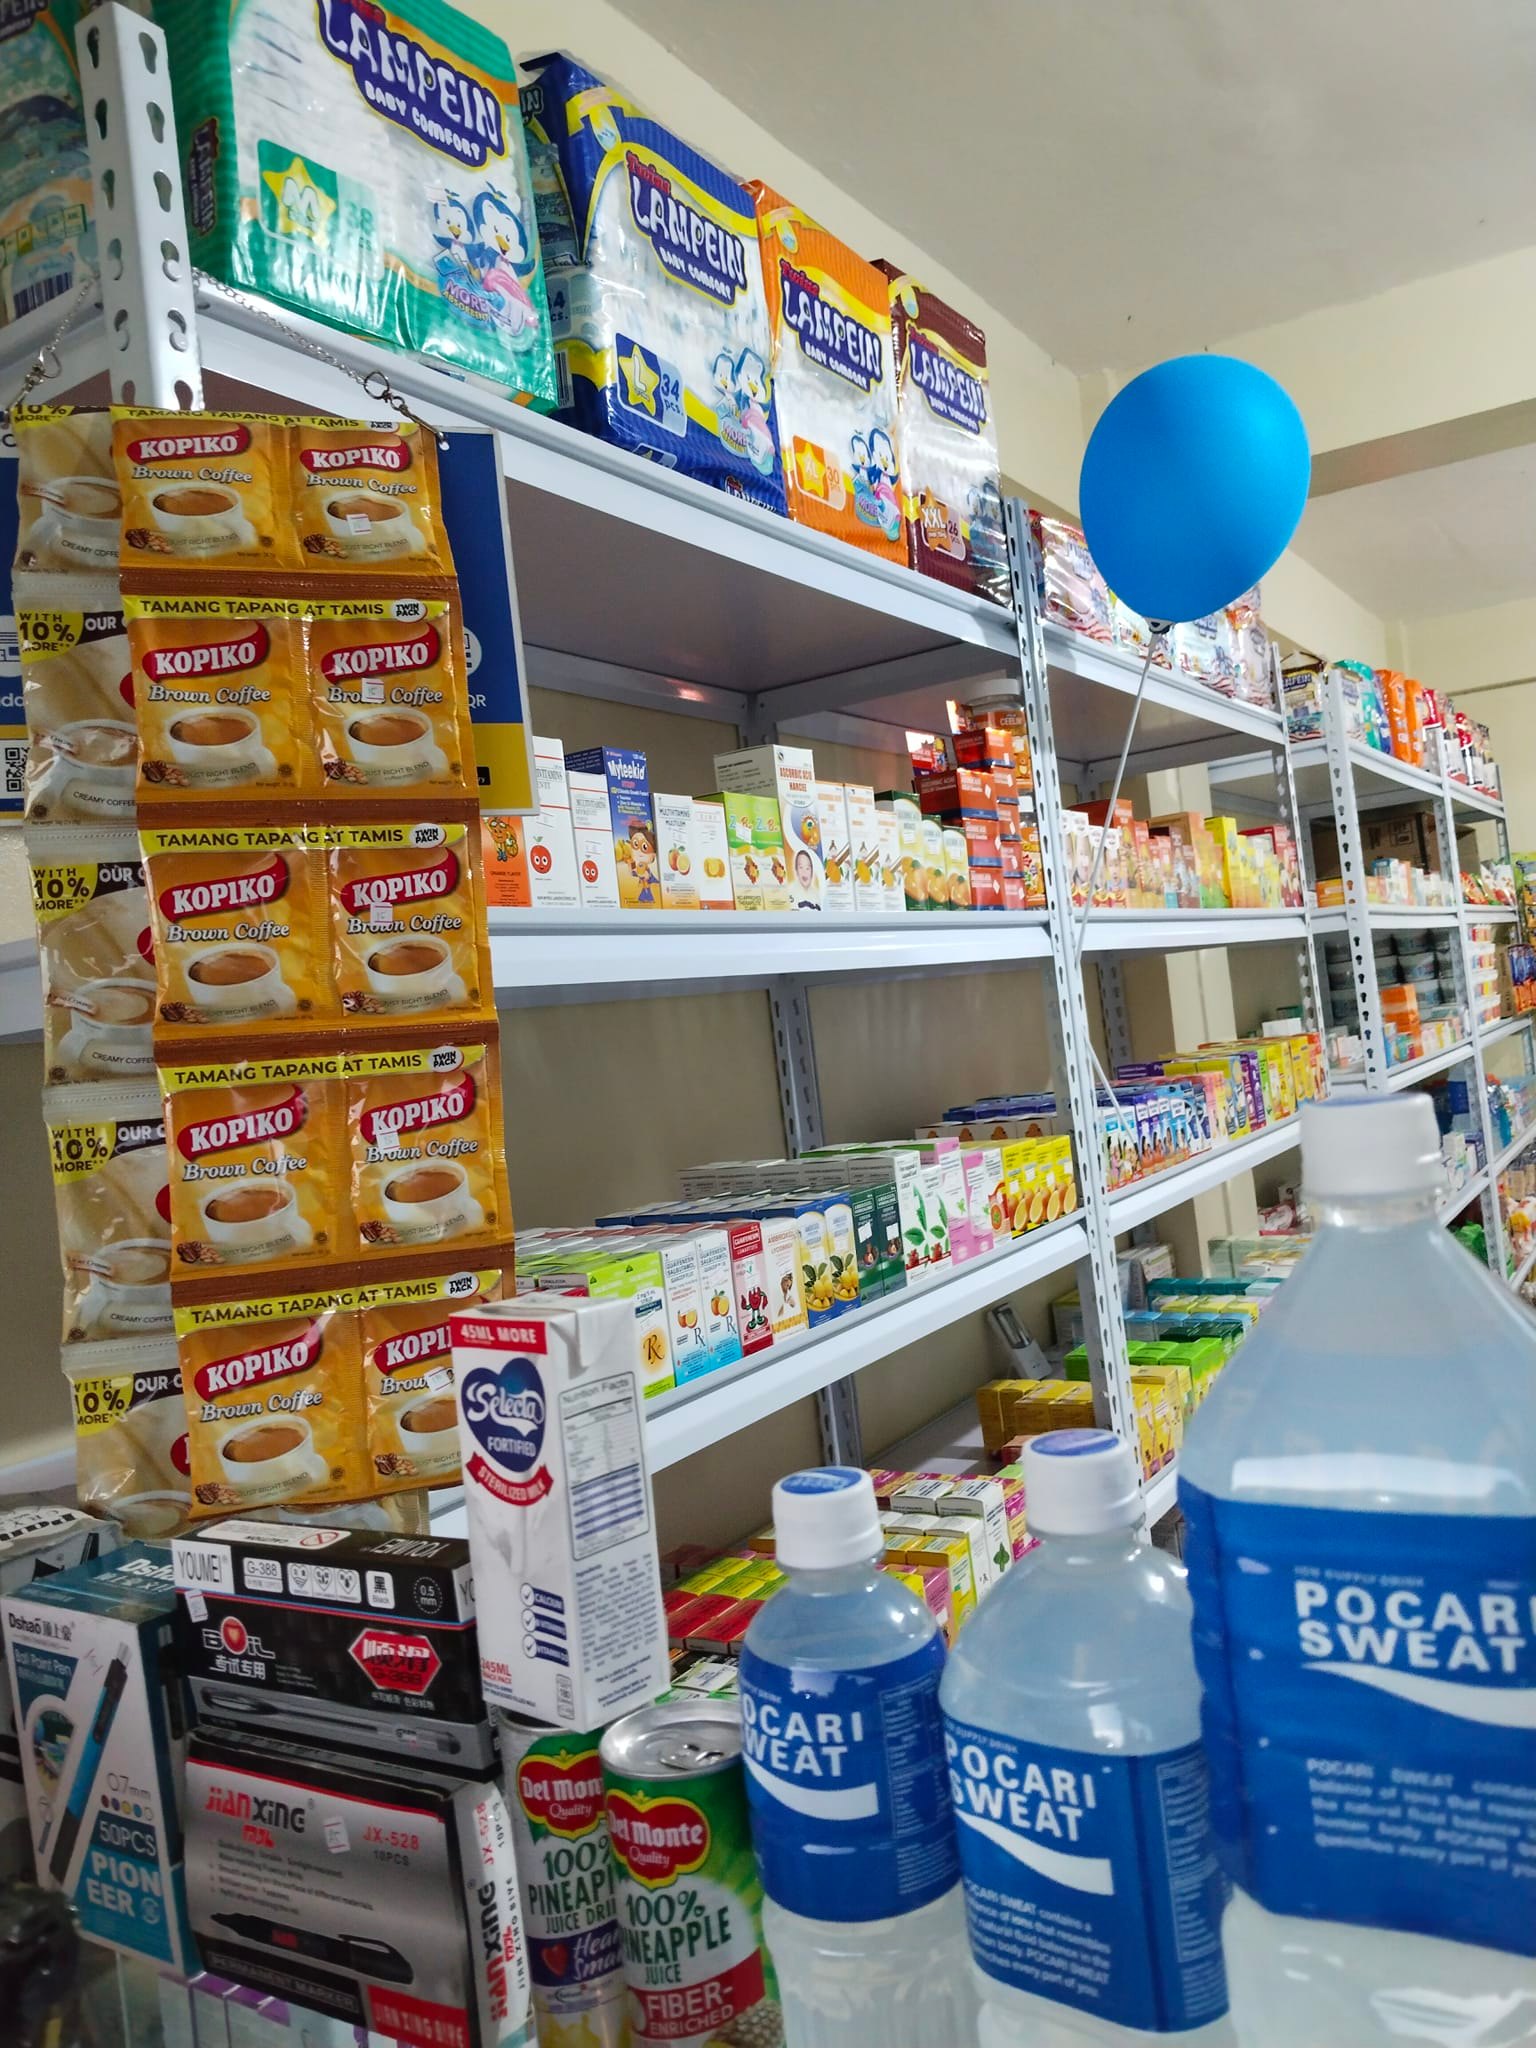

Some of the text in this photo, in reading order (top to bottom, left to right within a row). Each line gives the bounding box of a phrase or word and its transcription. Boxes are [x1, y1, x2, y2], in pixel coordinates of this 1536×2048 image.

[324, 0, 499, 147] LAMPEIN
[364, 80, 407, 116] BABY
[633, 175, 745, 286] LAMPEIN
[659, 246, 733, 300] BABY COMFORT
[784, 281, 882, 379] LAMPEIN
[633, 354, 649, 392] L
[805, 342, 868, 390] BABY COMFORT
[660, 373, 681, 402] 34
[910, 343, 987, 420] LAMPEIN
[310, 417, 359, 428] TAMIS
[139, 436, 239, 460] KOPIKO
[311, 448, 400, 470] KOPIKO
[132, 466, 253, 484] Brown Coffee
[307, 474, 417, 496] Brown Coffee
[922, 507, 947, 529] XXL
[61, 539, 92, 554] CREAMY
[19, 612, 63, 623] WITH
[141, 600, 384, 617] TAMANG TAPANG AT TAMIS
[395, 603, 420, 611] TWIN
[395, 609, 420, 618] PACK
[19, 622, 76, 643] 10%
[85, 615, 117, 631] OUR
[154, 642, 256, 676] KOPIKO
[332, 644, 429, 677] KOPIKO
[149, 685, 272, 706] Brown Coffee
[390, 687, 443, 706] Coffee
[608, 759, 646, 780] Myteekid
[73, 790, 105, 806] CREAMY
[156, 829, 404, 848] TAMANG TAPANG AT TAMIS
[415, 827, 440, 836] TWIN
[415, 834, 440, 844] PACK
[34, 868, 77, 878] WITH
[100, 866, 133, 883] OUR
[34, 877, 90, 900] 10%
[171, 874, 276, 914] KOPIKO
[352, 869, 447, 907] KOPIKO
[167, 920, 290, 943] Brown Coffee
[347, 914, 463, 935] Brown Coffee
[92, 1051, 126, 1065] CREAMY
[432, 1051, 457, 1062] TWIN
[432, 1057, 458, 1068] PACK
[175, 1054, 422, 1084] TAMANG TAPANG AT TAMIS
[371, 1092, 465, 1137] KOPIKO
[52, 1127, 95, 1139] WITH
[117, 1125, 152, 1141] OUR
[190, 1107, 294, 1153] KOPIKO
[53, 1138, 109, 1161] 10%
[366, 1138, 479, 1163] Brown Coffee
[182, 1155, 308, 1181] Brown Coffee
[449, 1277, 474, 1289] TWIN
[449, 1283, 475, 1295] PACK
[191, 1282, 438, 1324] TAMANG TAPANG AT TAMIS
[110, 1313, 142, 1323] CREAMY
[460, 1323, 537, 1345] 45ML MORE
[386, 1326, 451, 1368] KOPI
[206, 1340, 310, 1393] KOPIKO
[135, 1374, 169, 1393] OUR
[601, 1378, 630, 1393] Facts
[76, 1389, 125, 1415] 10%
[201, 1390, 323, 1423] Brown Coffee
[466, 1381, 545, 1432] Selecta
[487, 1436, 537, 1458] FORTIFIED
[477, 1465, 546, 1502] STERILIZED MILK
[176, 1549, 223, 1584] YOUMEI
[247, 1560, 278, 1577] G-388
[1324, 1568, 1377, 1585] SUPPLY
[373, 1576, 387, 1594] 黑
[420, 1584, 436, 1598] 0.5
[419, 1596, 438, 1607] mm
[1297, 1619, 1527, 1674] SWEAT
[209, 1654, 267, 1681] 考试专用
[742, 1692, 864, 1744] OCARI
[744, 1724, 849, 1777] WEAT
[944, 1731, 1097, 1809] POCARI
[1306, 1757, 1454, 1788] POCARI SWEAT
[521, 1775, 603, 1801] Del Mon
[549, 1803, 592, 1820] Quality
[949, 1767, 1083, 1842] SWEAT
[100, 1820, 156, 1857] 50PCS
[363, 1825, 420, 1851] JX-528
[475, 1803, 495, 1866] JX-528
[608, 1810, 704, 1848] Del Monte
[373, 1849, 410, 1866] 10PCS
[544, 1836, 611, 1879] 100%
[629, 1846, 671, 1868] Quality
[91, 1850, 163, 1897] PION
[86, 1877, 136, 1917] EER
[626, 1889, 706, 1927] 100%
[545, 1914, 580, 1935] JUICE
[623, 1905, 732, 1966] INEAPPLE
[645, 1963, 682, 1986] JUICE
[645, 1981, 734, 2020] FIBER-
[650, 2004, 735, 2037] ENRICHED
